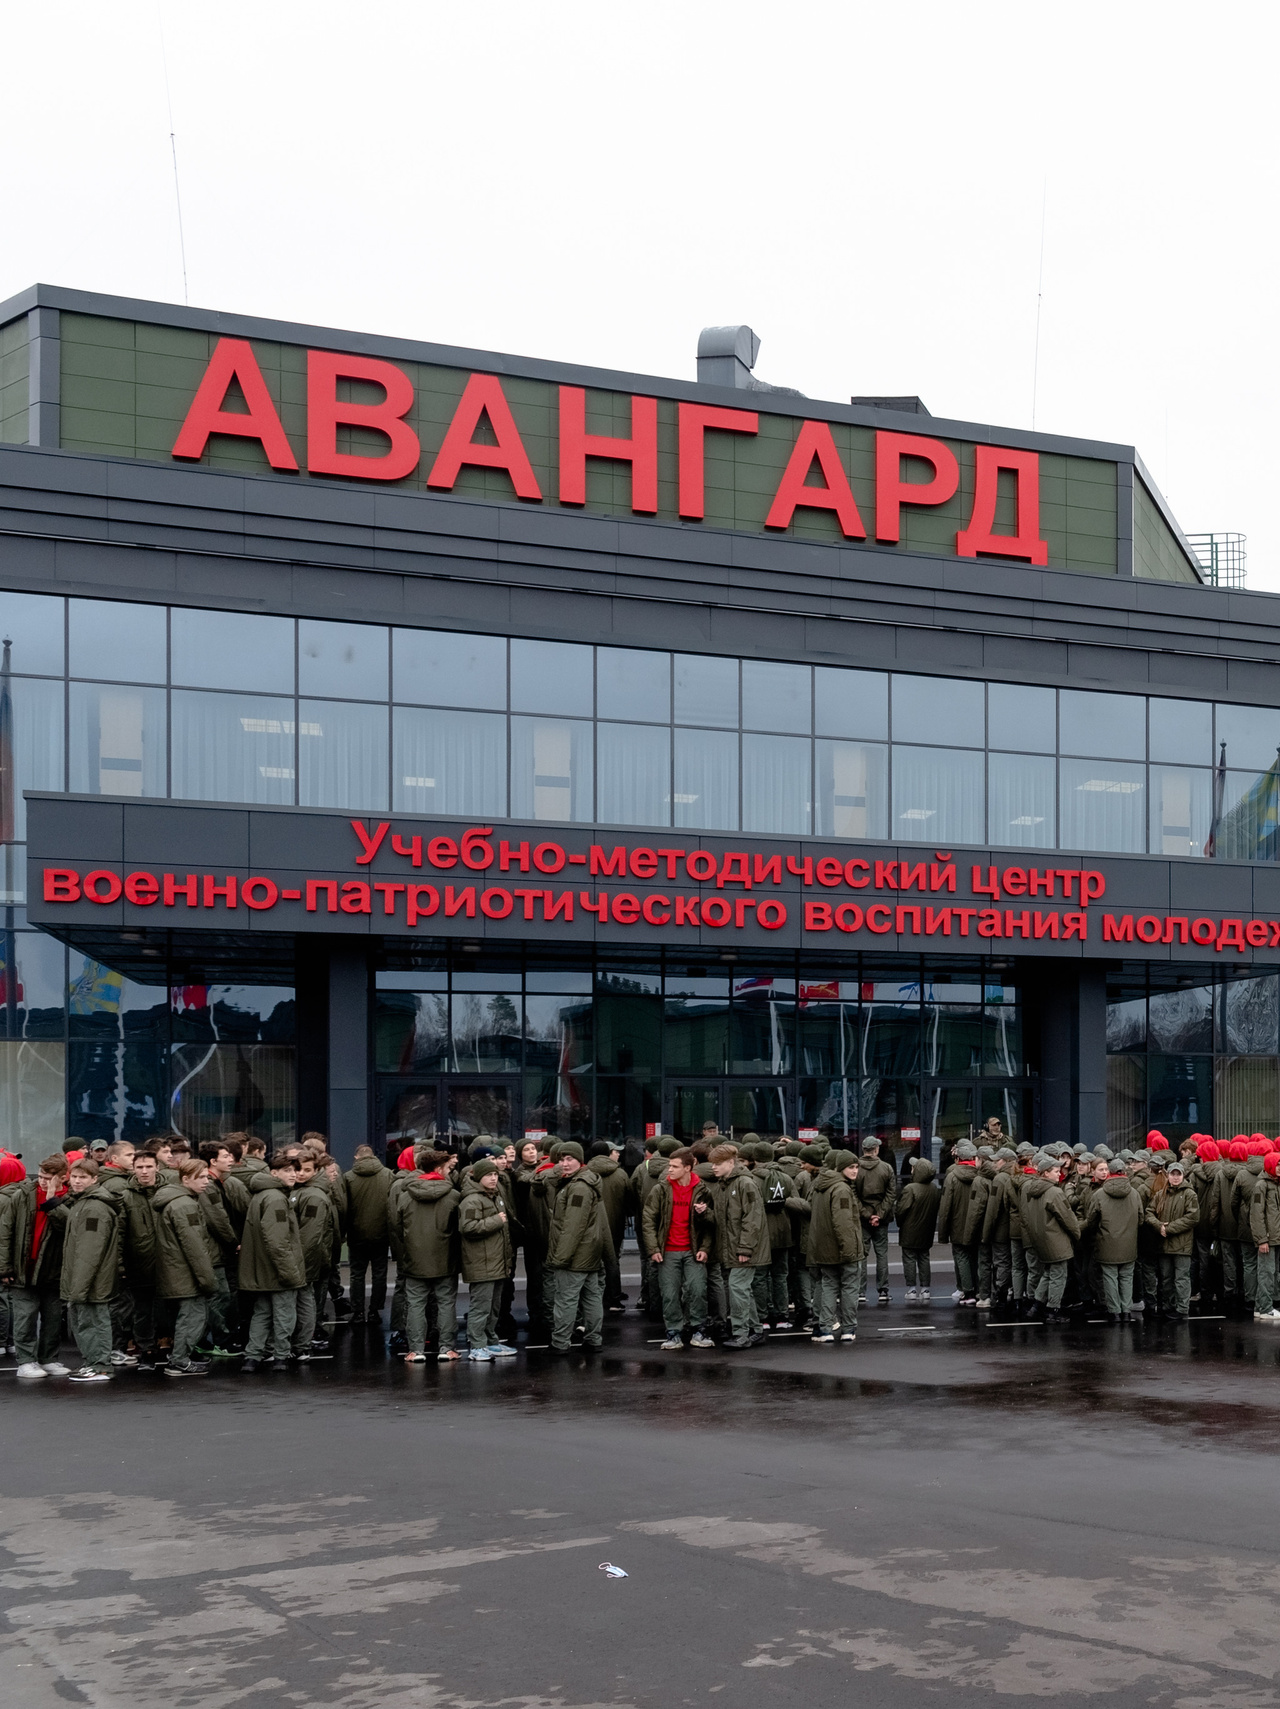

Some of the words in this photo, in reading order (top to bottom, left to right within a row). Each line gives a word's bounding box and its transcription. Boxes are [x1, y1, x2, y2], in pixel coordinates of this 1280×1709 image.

[171, 337, 1049, 566] АВАНГАРД
[43, 868, 788, 929] военно-патриотического
[804, 901, 1088, 940] воспитания
[351, 820, 957, 892] Учебно-методический
[972, 864, 1106, 907] центр
